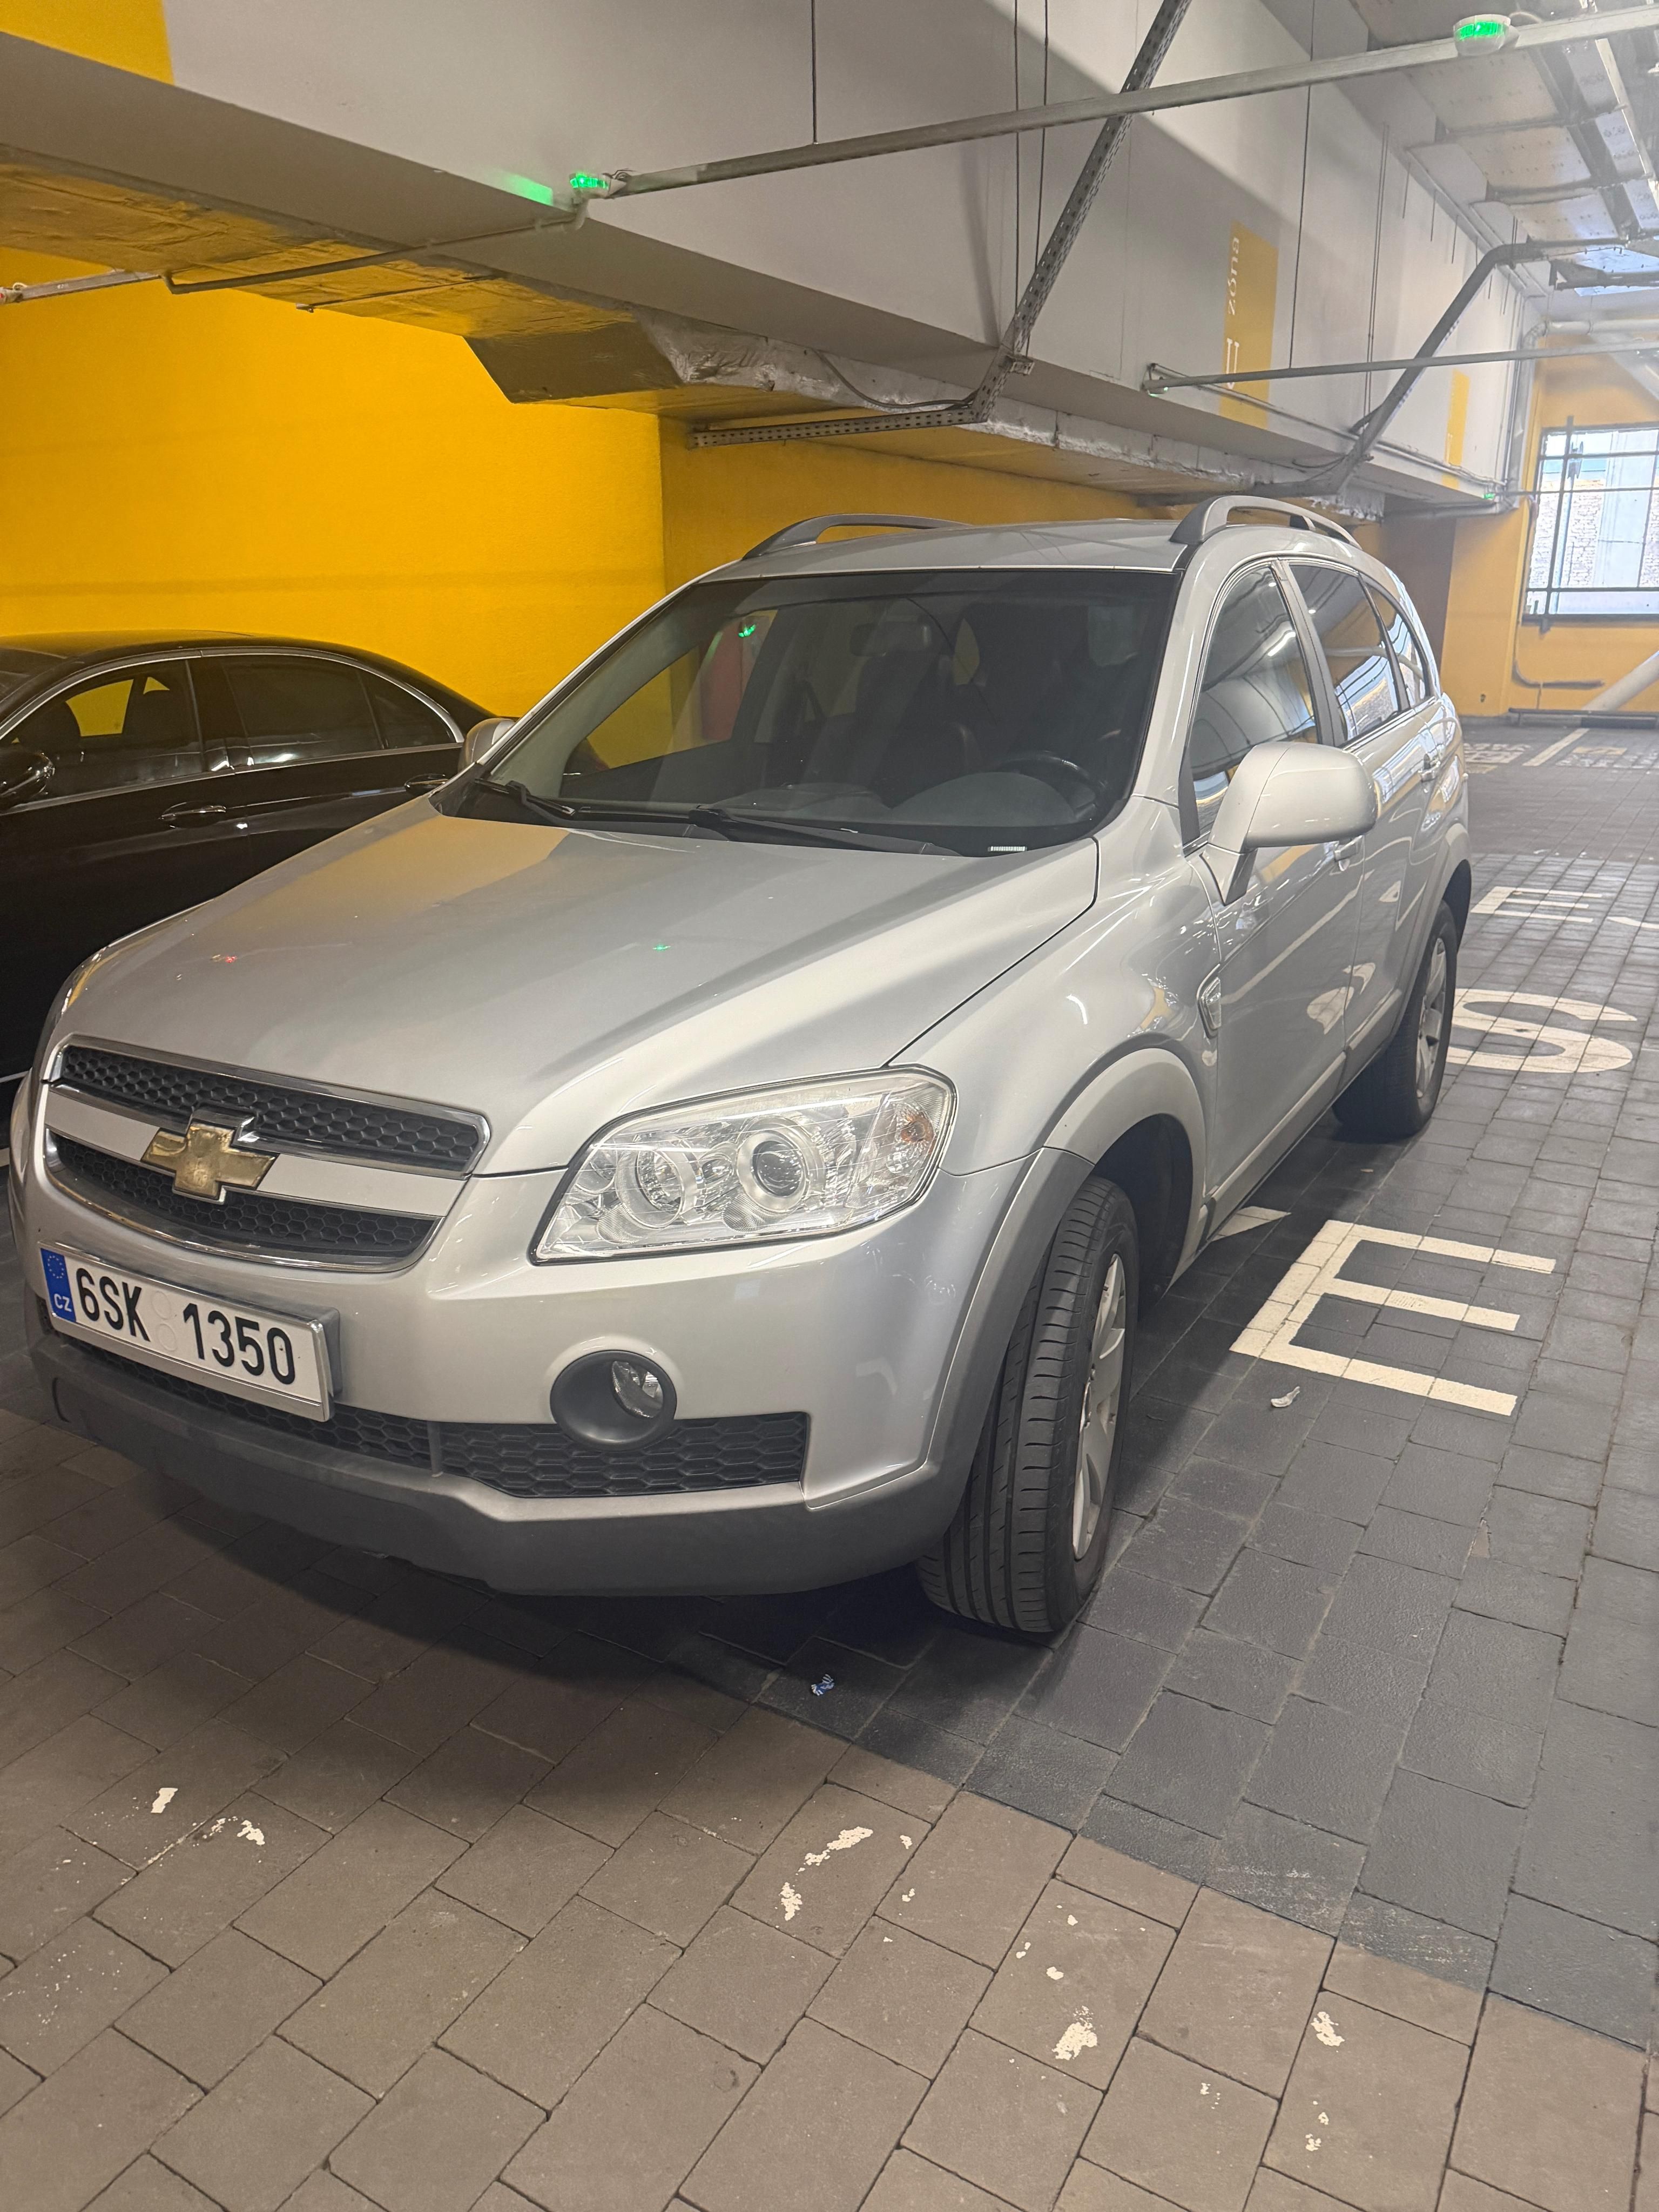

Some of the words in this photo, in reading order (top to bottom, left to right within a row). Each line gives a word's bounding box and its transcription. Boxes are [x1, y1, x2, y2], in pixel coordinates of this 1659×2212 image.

[1228, 237, 1239, 315] zóna
[55, 1293, 72, 1312] CZ
[76, 1268, 150, 1341] 6SK
[183, 1303, 295, 1385] 1350
